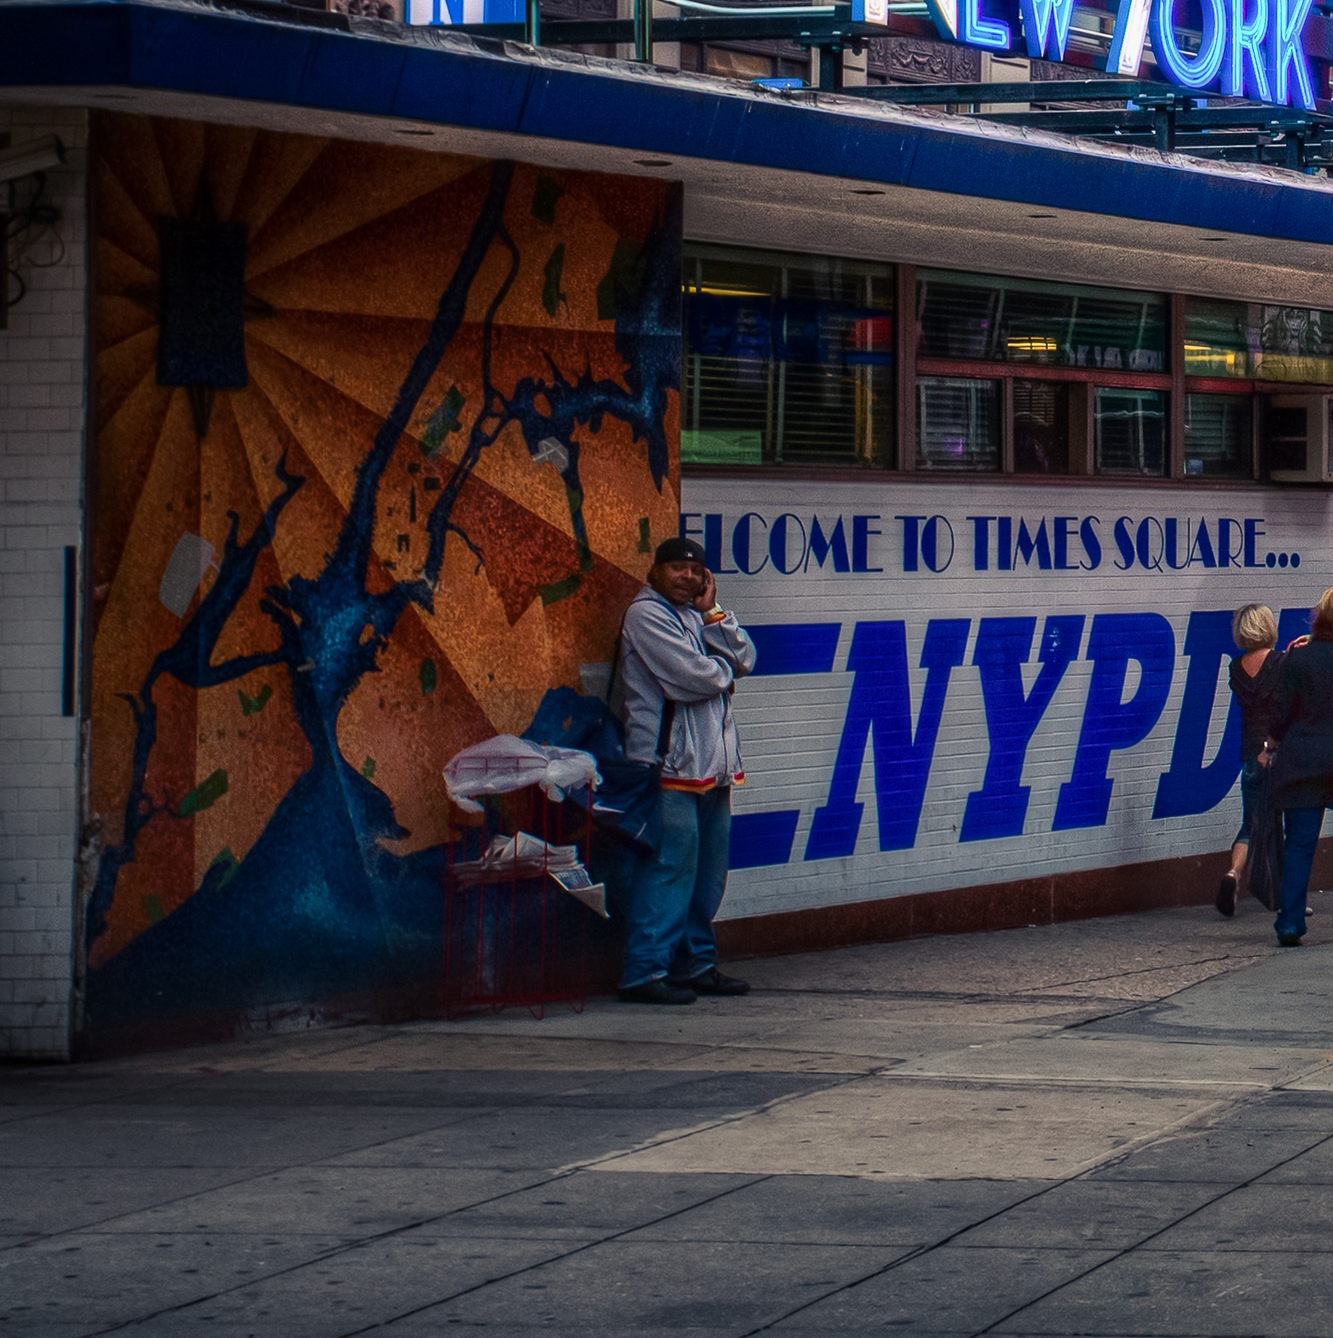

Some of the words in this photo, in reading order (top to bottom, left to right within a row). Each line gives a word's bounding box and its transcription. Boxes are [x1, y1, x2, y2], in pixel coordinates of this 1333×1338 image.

[894, 515, 955, 574] TO
[966, 515, 1102, 574] TIMES
[1114, 514, 1301, 573] SQUARE...
